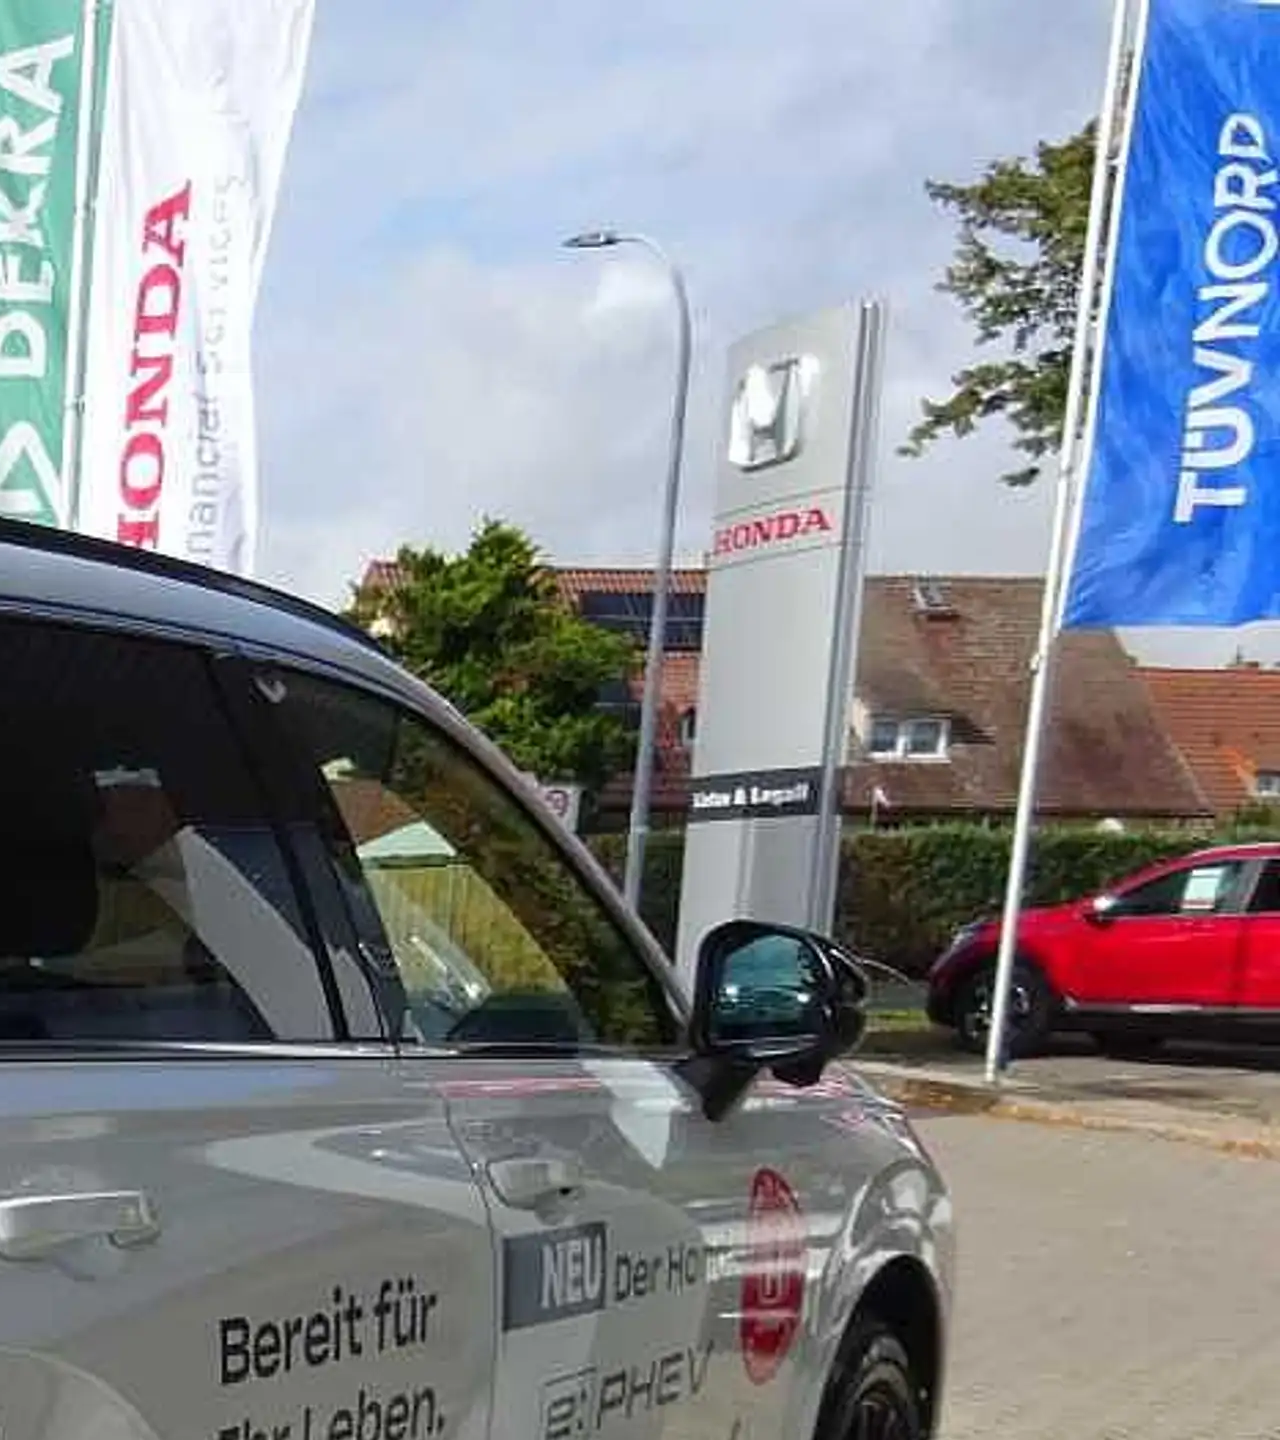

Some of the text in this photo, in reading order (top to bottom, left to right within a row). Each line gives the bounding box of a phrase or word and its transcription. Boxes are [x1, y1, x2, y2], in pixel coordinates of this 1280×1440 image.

[714, 508, 832, 557] HONDA
[541, 1236, 608, 1308] NEU
[613, 1253, 662, 1301] Der
[218, 1276, 437, 1385] Bereit für
